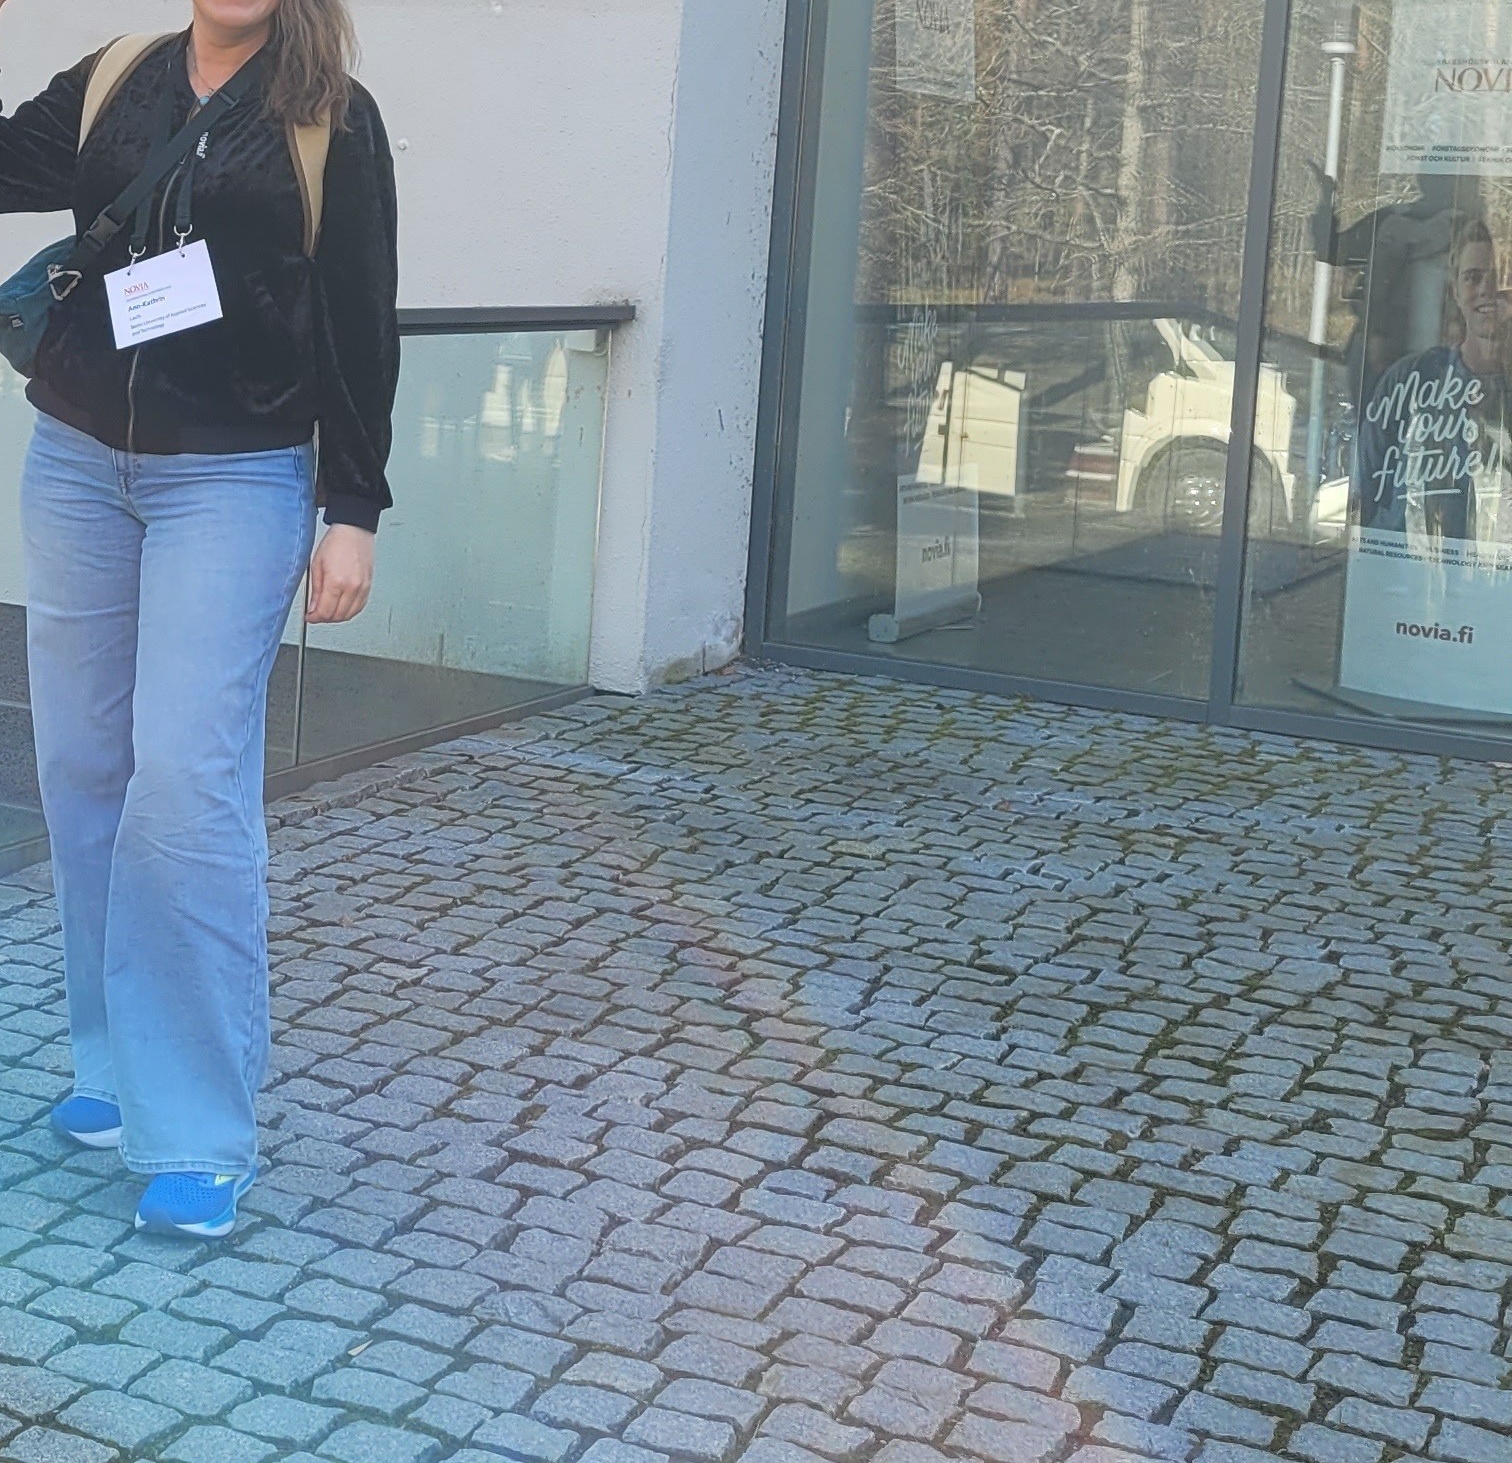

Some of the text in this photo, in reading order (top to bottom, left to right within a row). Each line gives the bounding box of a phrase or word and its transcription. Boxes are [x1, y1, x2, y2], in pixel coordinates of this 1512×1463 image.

[1435, 67, 1512, 93] NOVI
[1366, 364, 1485, 430] Make
[1397, 407, 1479, 455] your
[1396, 620, 1474, 645] novia.fi
